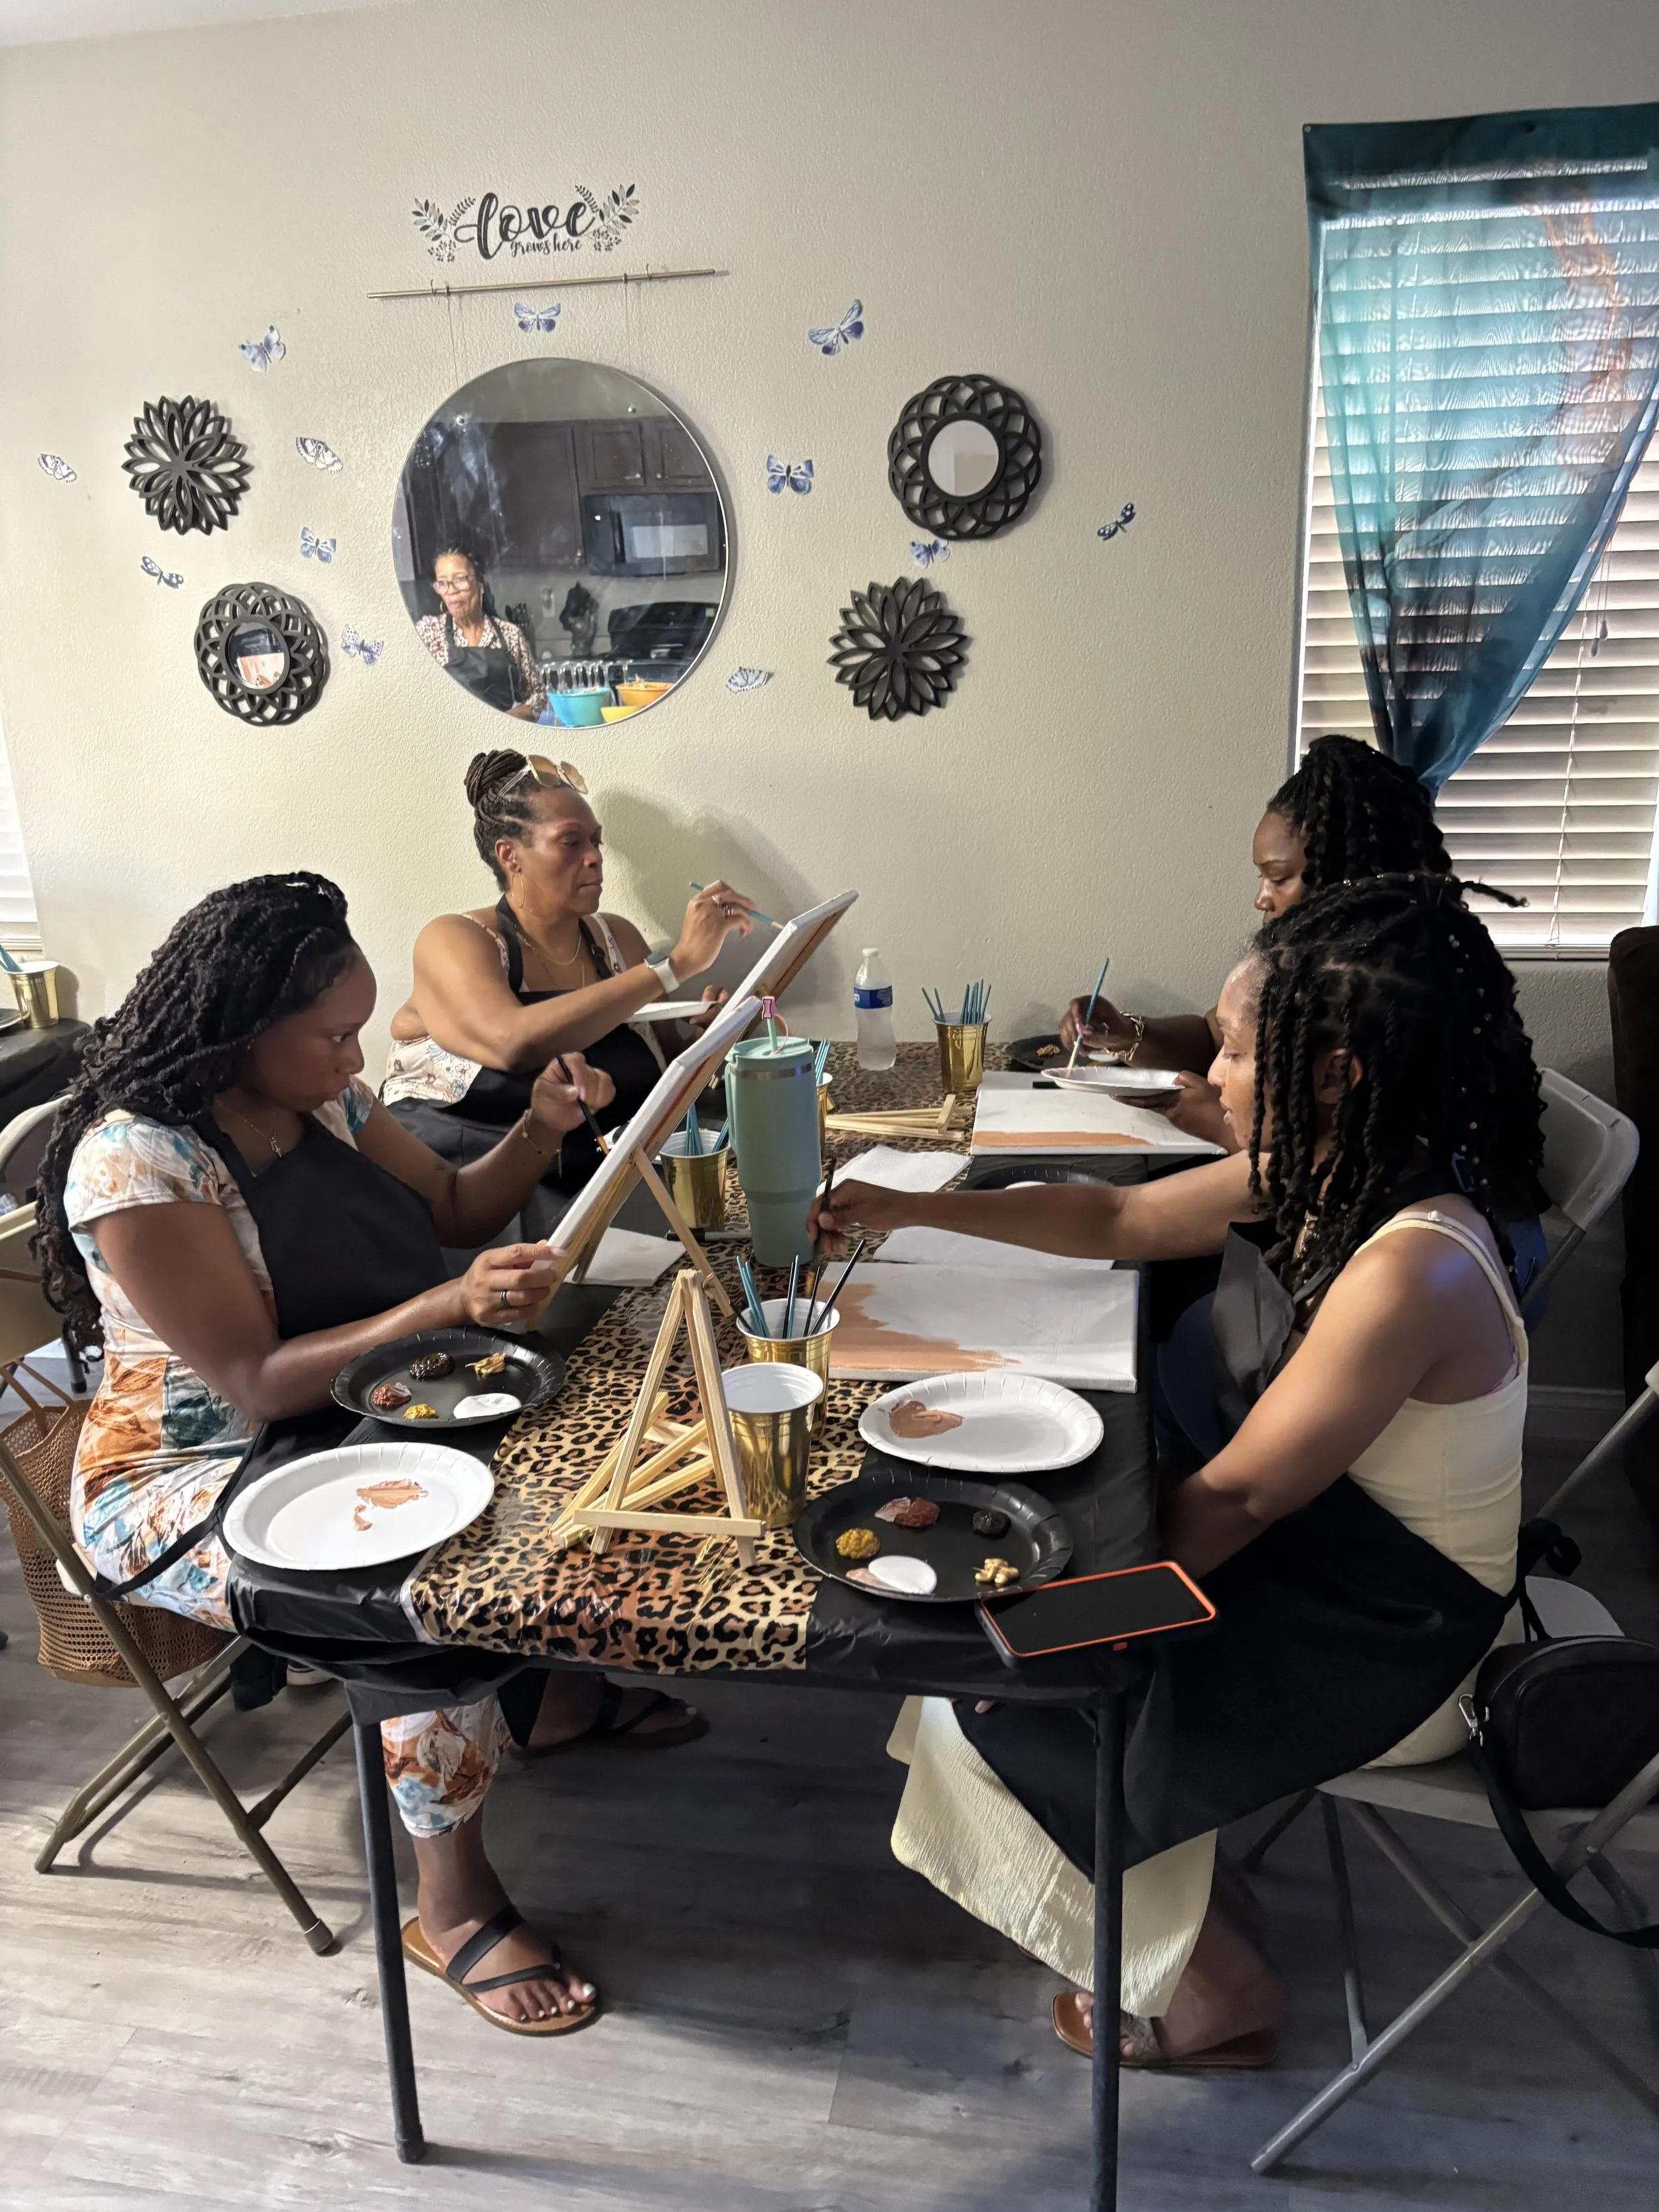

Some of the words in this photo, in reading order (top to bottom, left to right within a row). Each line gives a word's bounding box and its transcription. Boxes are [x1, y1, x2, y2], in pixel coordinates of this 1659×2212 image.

[454, 192, 595, 259] love
[510, 240, 551, 258] grows
[553, 232, 582, 252] here
